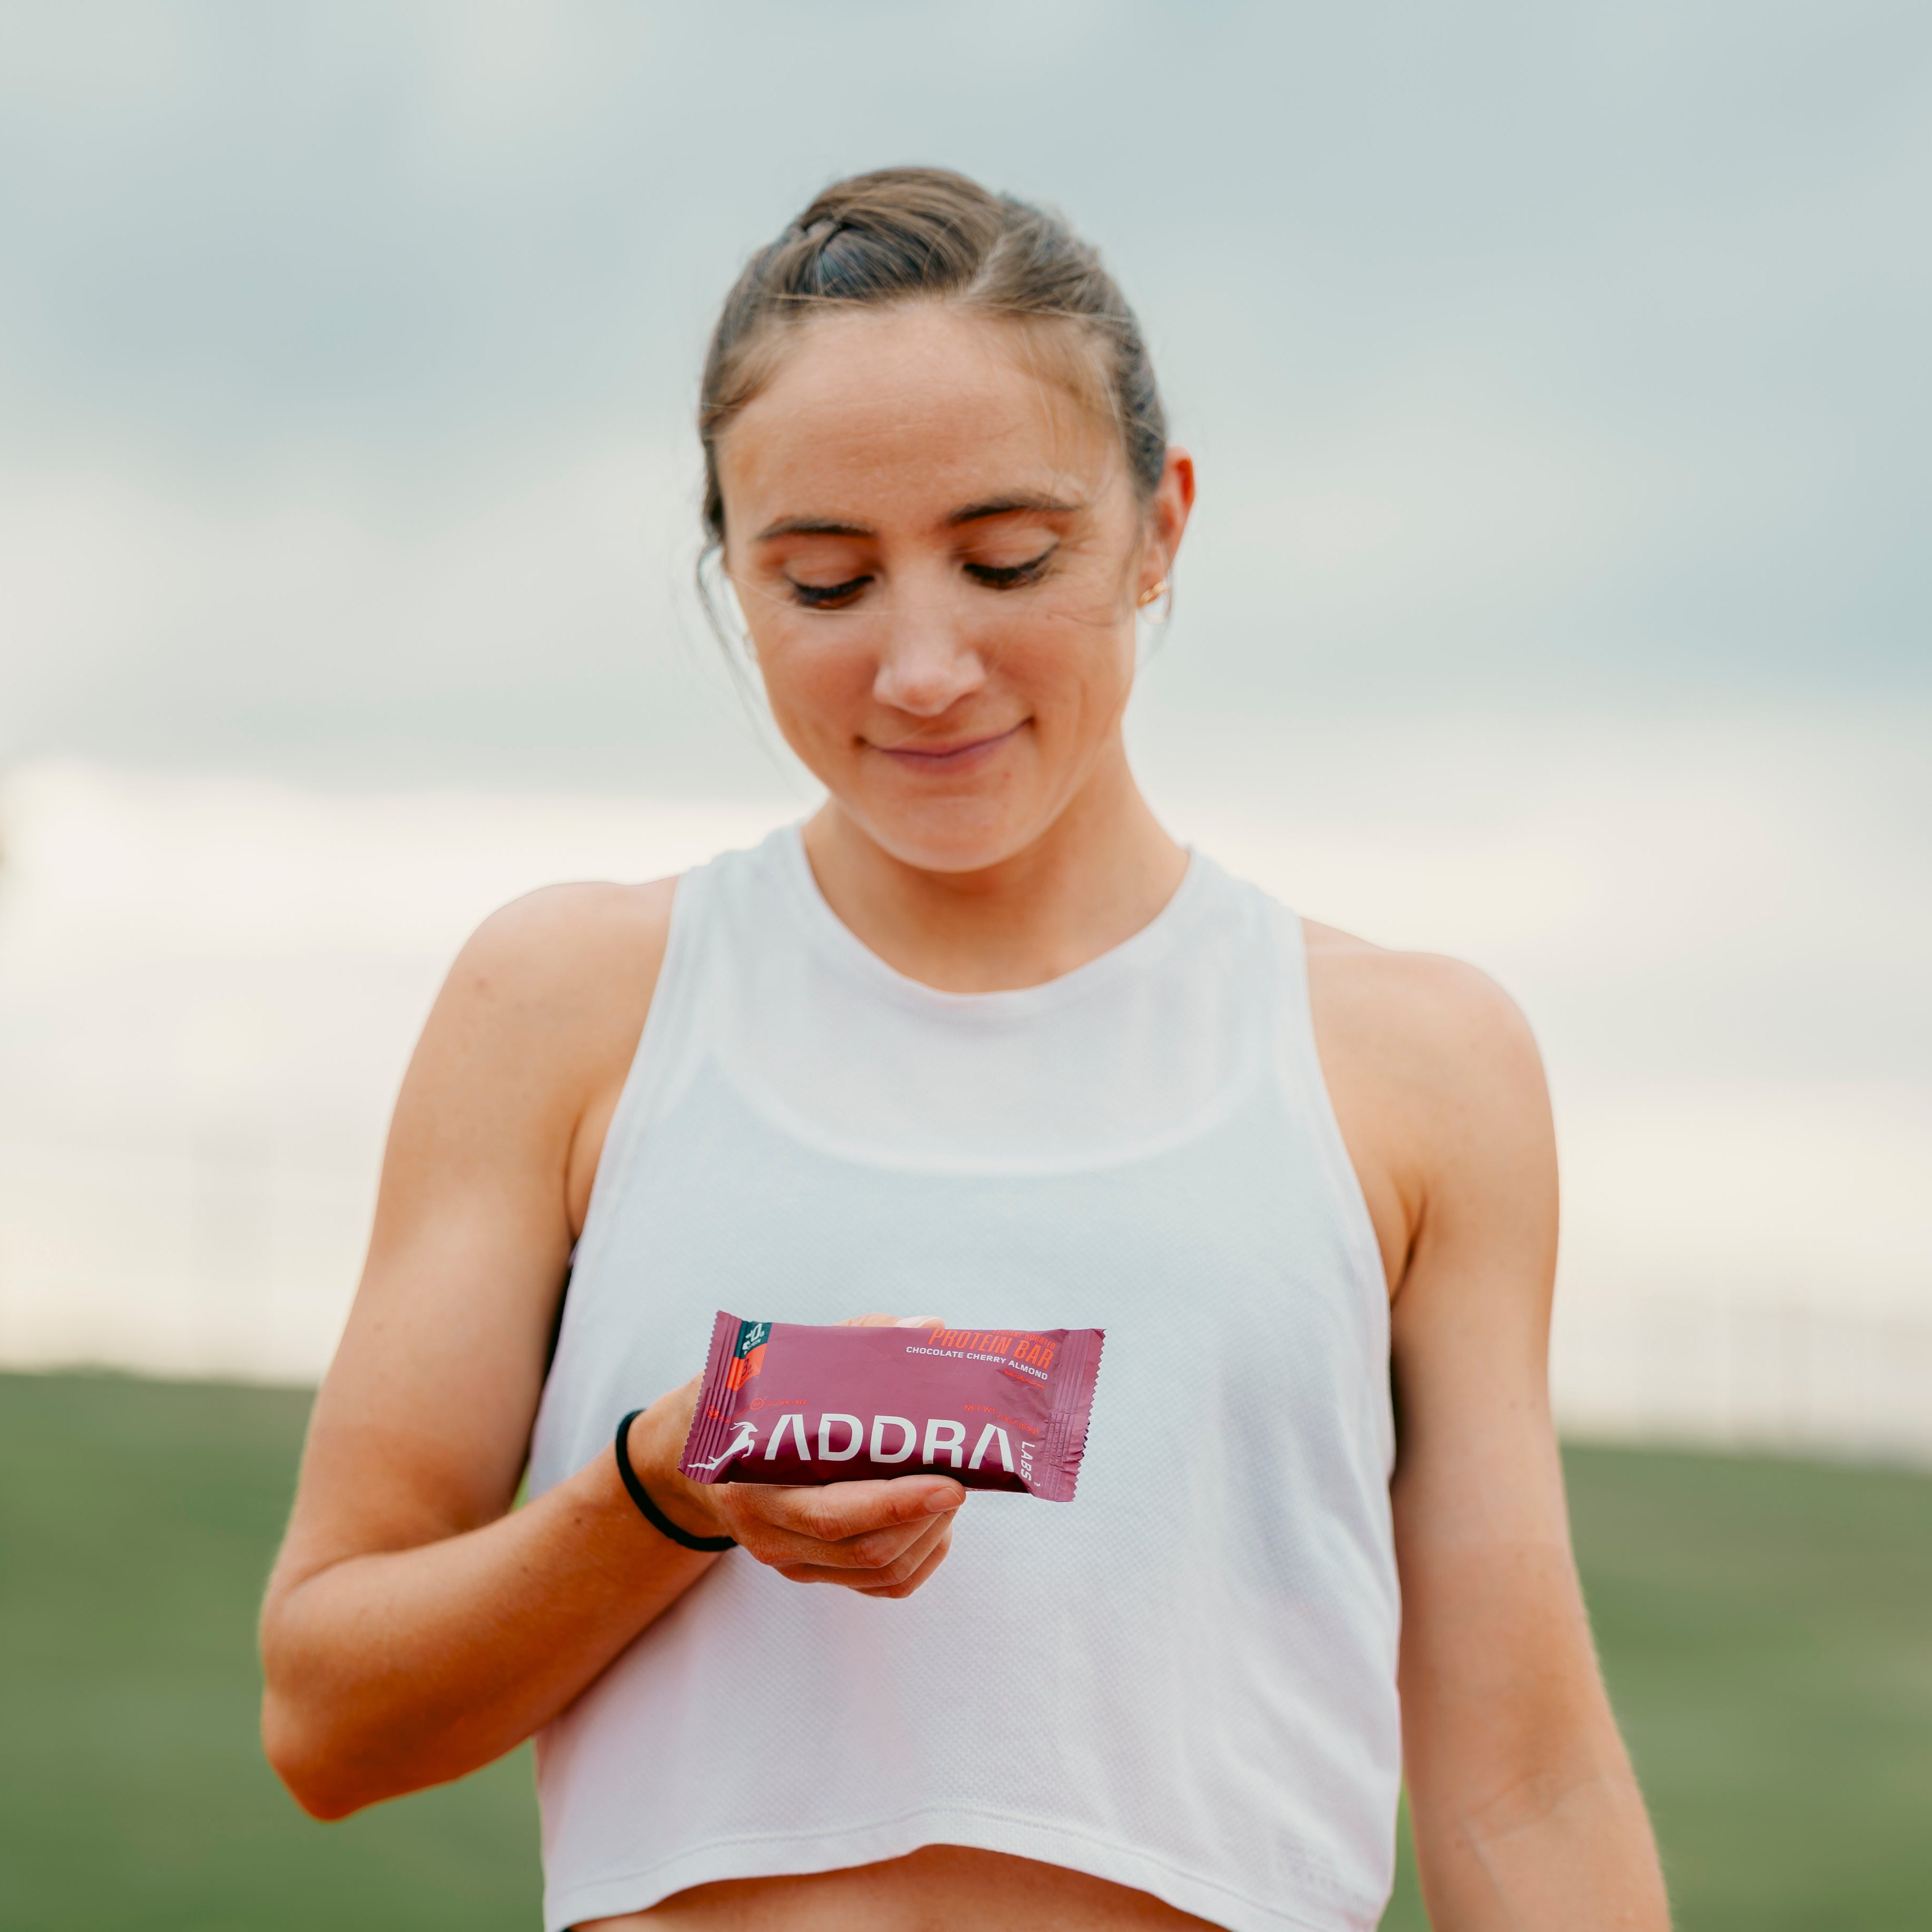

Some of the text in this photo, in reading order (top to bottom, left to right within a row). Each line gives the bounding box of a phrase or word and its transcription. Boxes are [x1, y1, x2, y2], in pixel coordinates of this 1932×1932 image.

[906, 1346, 1048, 1380] CHOCOLATE CHERRY ALMOND
[928, 1329, 1054, 1370] PROTEIN BAR
[983, 1406, 997, 1415] WT
[1018, 1422, 1040, 1436] (65g)
[764, 1413, 1014, 1472] ADDRA
[1021, 1441, 1035, 1481] LABS
